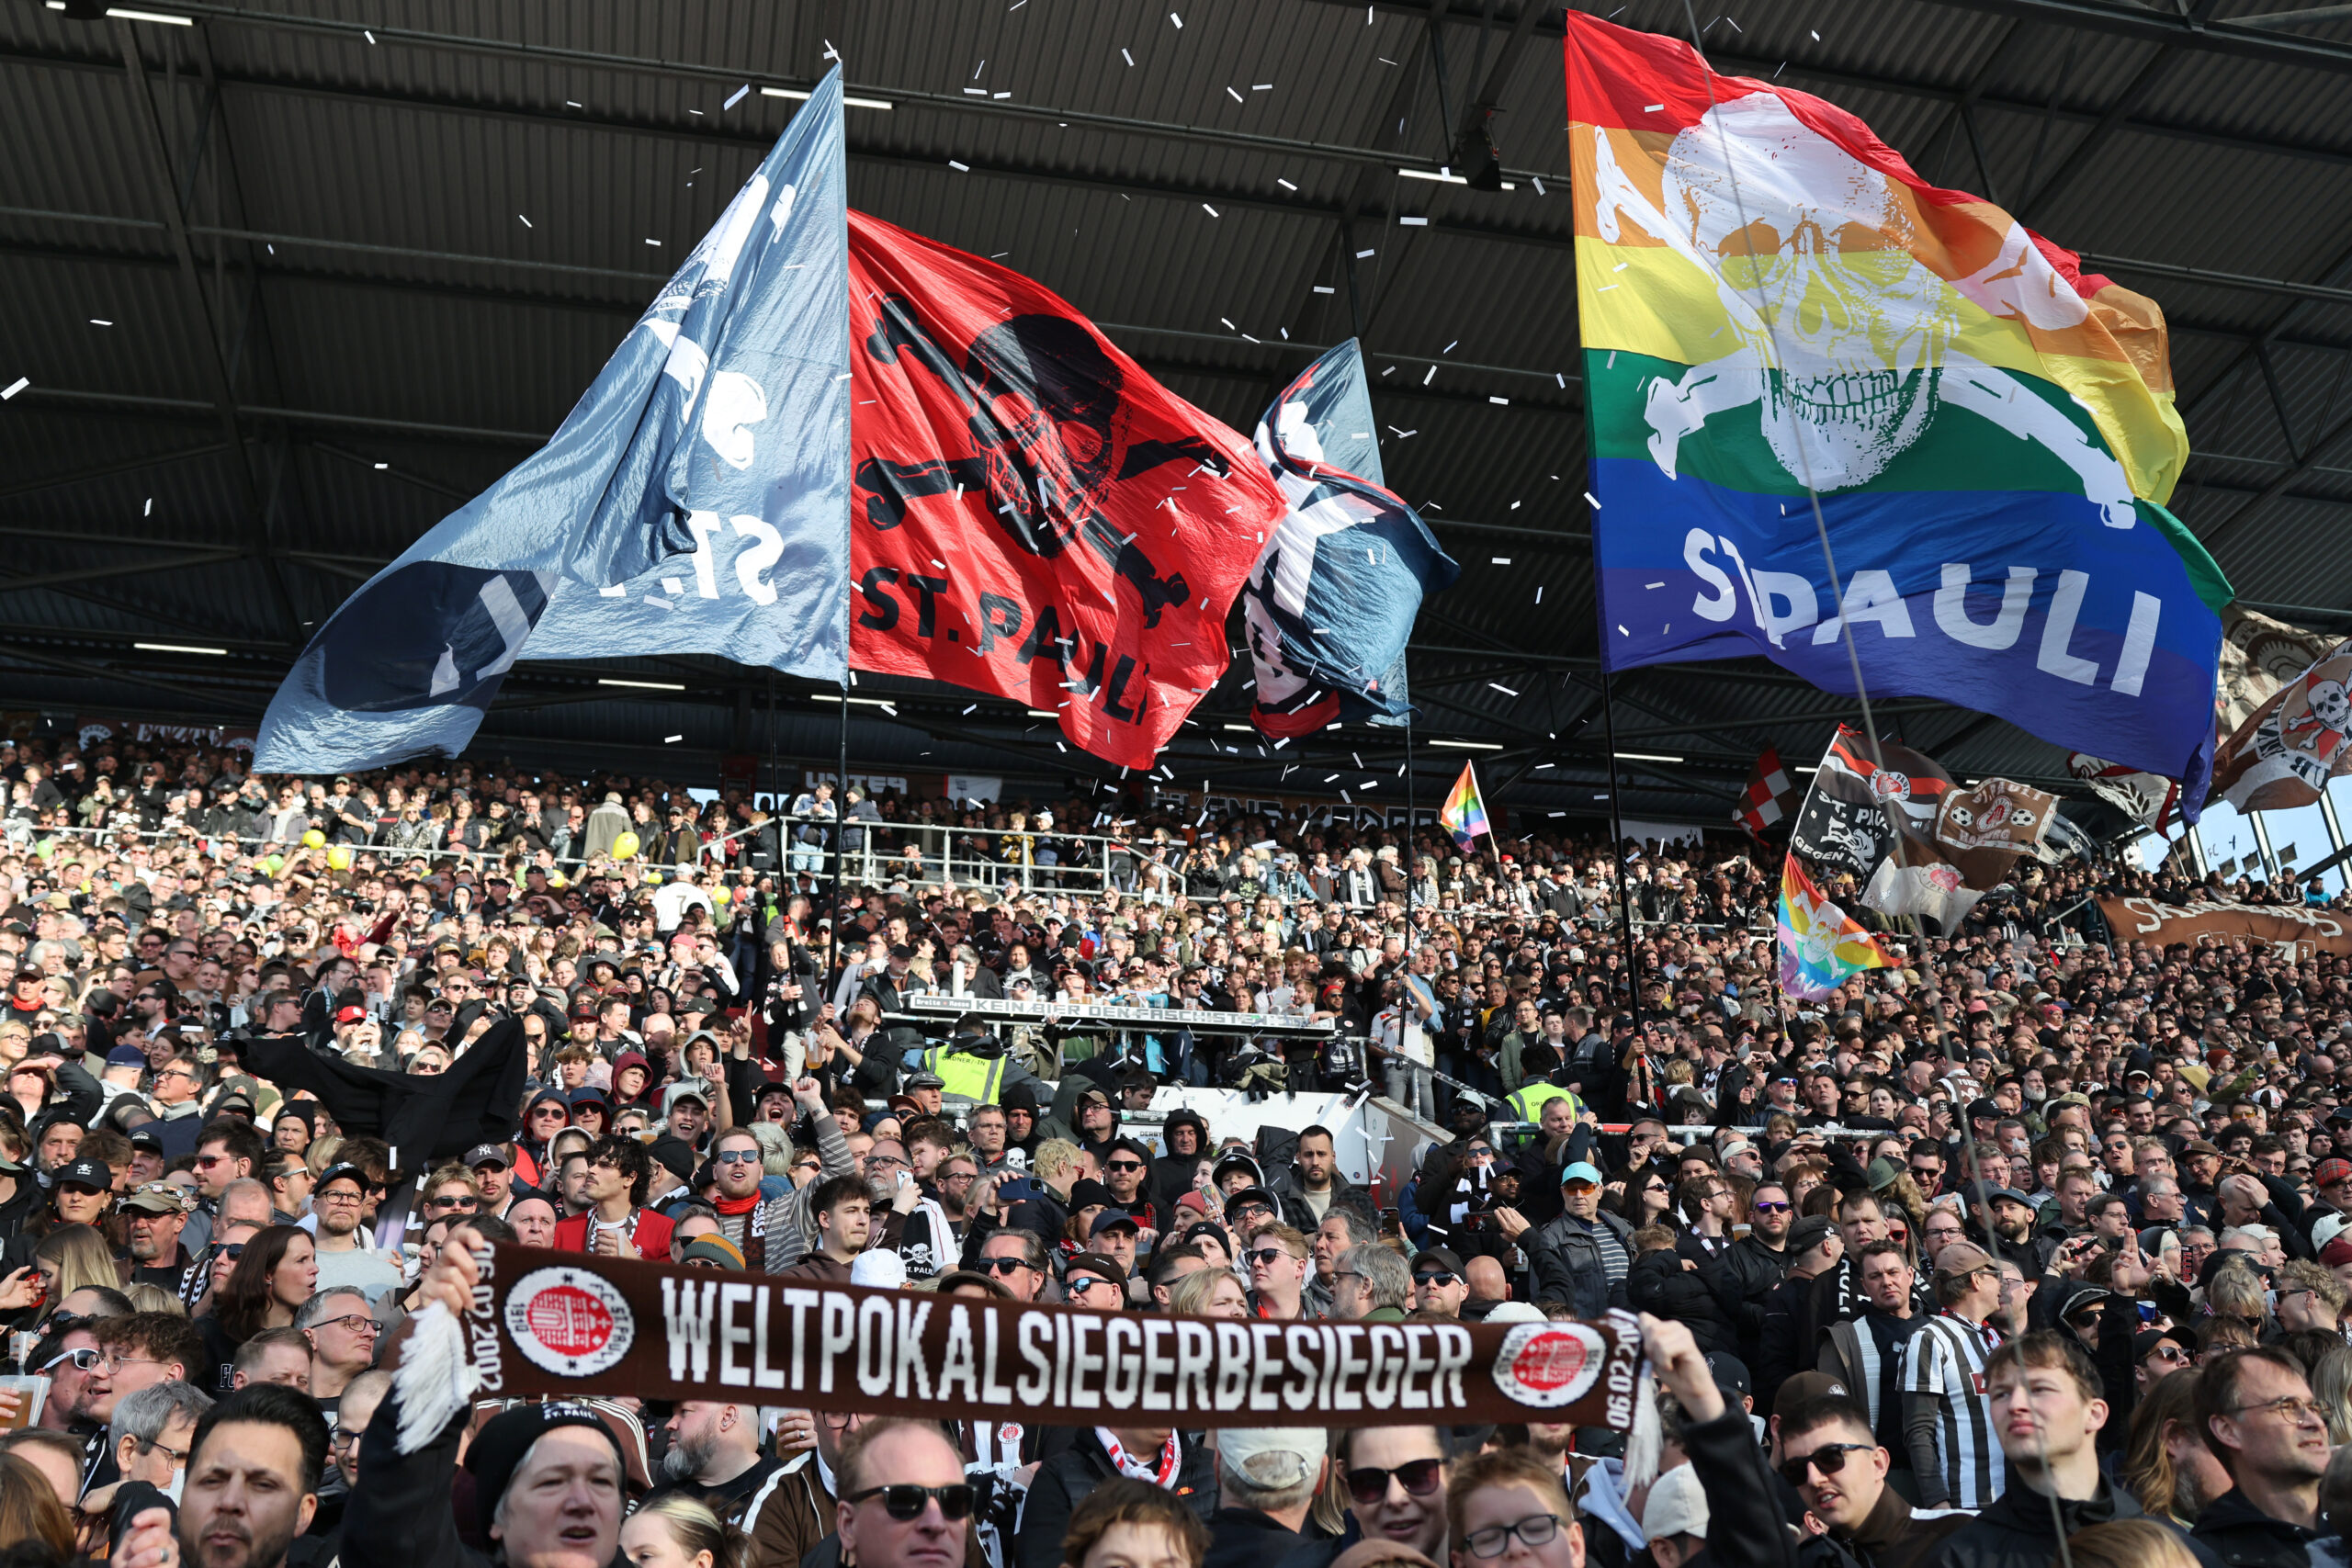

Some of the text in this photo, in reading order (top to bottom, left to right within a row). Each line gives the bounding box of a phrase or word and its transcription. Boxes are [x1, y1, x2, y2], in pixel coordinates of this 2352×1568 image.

[1749, 563, 2161, 697] PAULI
[858, 567, 959, 640] ST.
[978, 592, 1151, 726] PAULI
[805, 771, 908, 795] UNTER
[1818, 790, 1847, 818] ST.
[1794, 835, 1845, 862] GEGEN
[976, 999, 1024, 1012] KEIN
[1032, 1002, 1080, 1016] BIER
[1089, 1006, 1130, 1020] DEN
[511, 1303, 529, 1334] 1910
[593, 1325, 628, 1364] PAULI
[662, 1277, 1471, 1411] WELTPOKALSIEGERBESIEGER
[563, 1409, 598, 1421] PAULI
